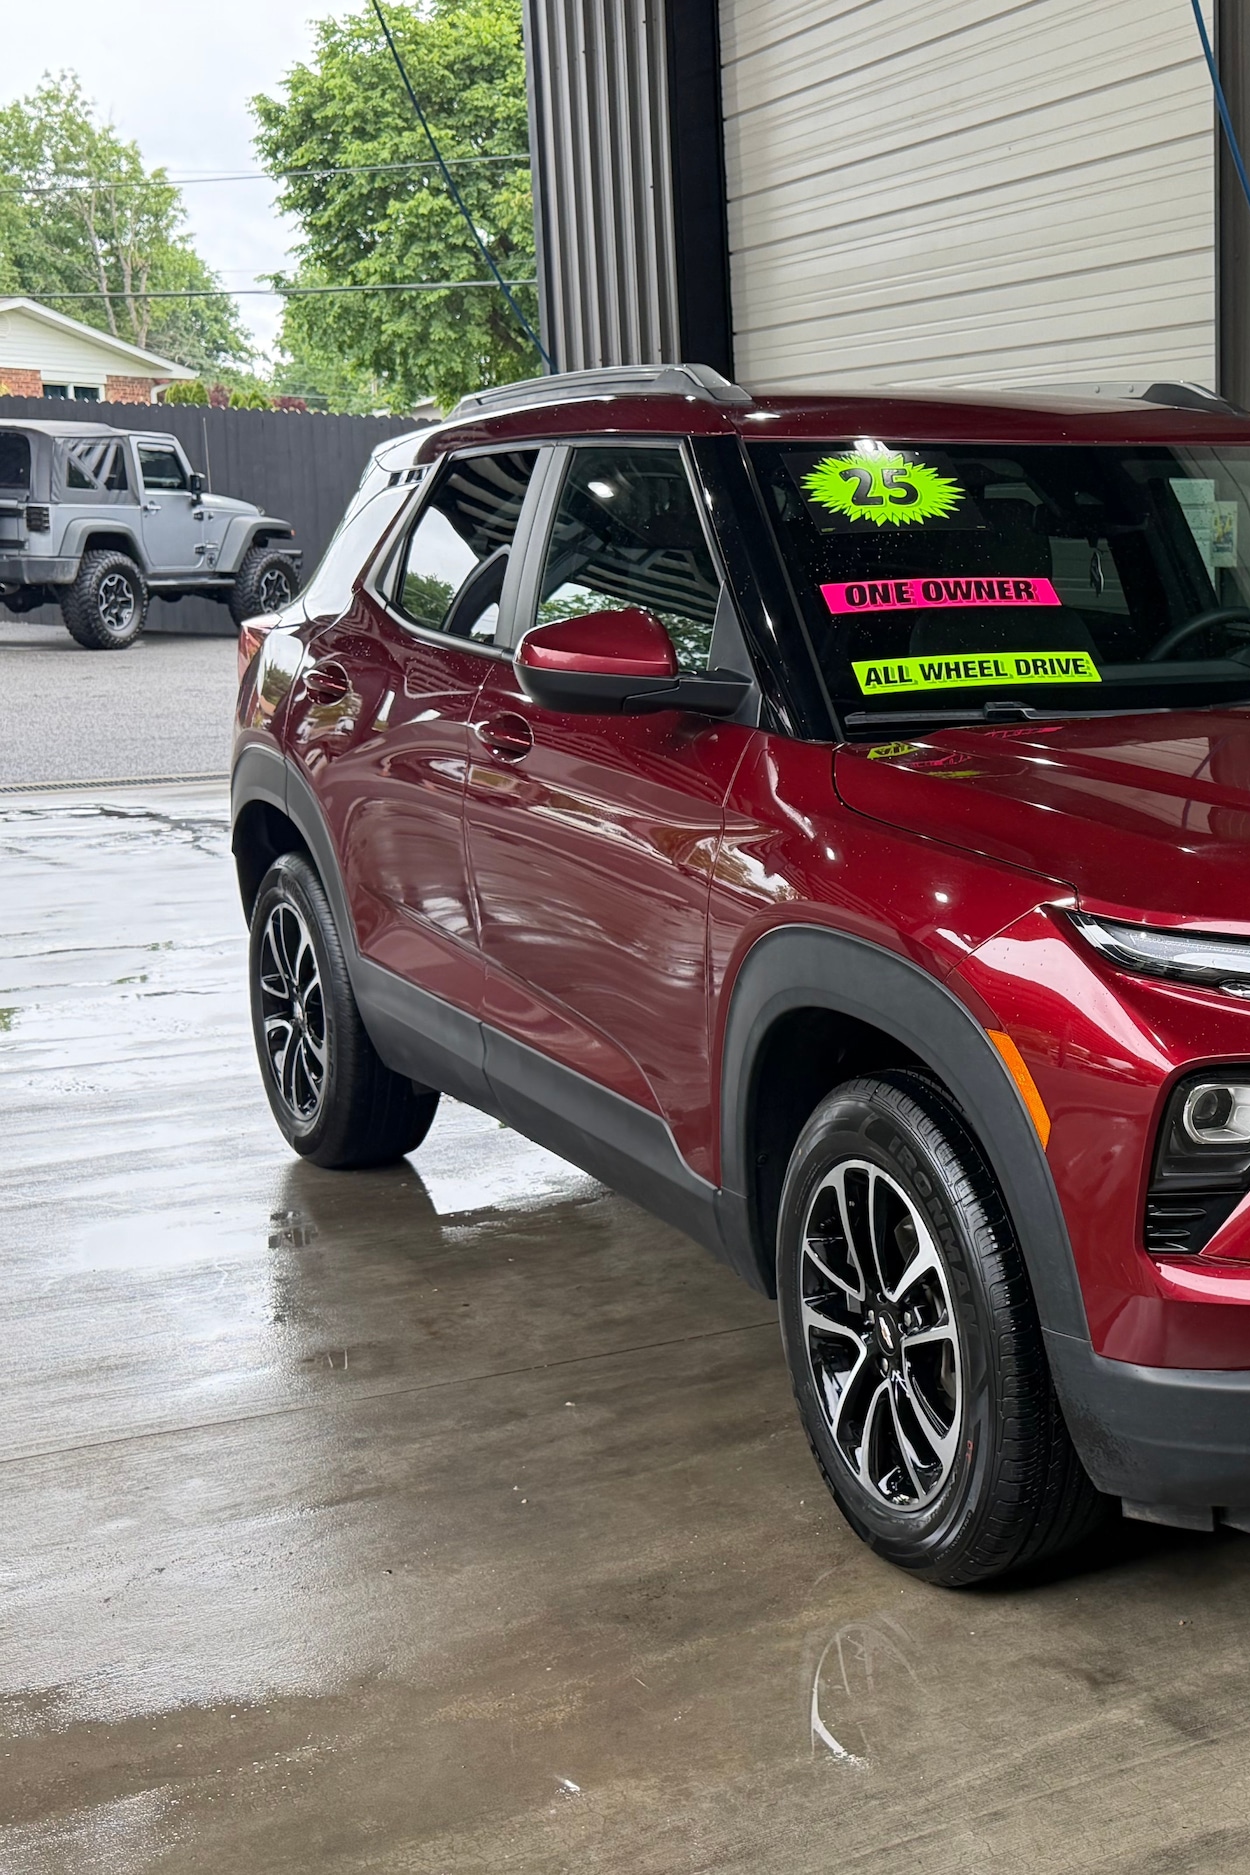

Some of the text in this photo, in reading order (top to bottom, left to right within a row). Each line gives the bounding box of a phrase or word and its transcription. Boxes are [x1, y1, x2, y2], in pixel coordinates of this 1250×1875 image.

[839, 467, 919, 506] 25
[845, 579, 1036, 607] ONE OWNER
[864, 657, 1089, 687] ALL WHEEL DRIVE
